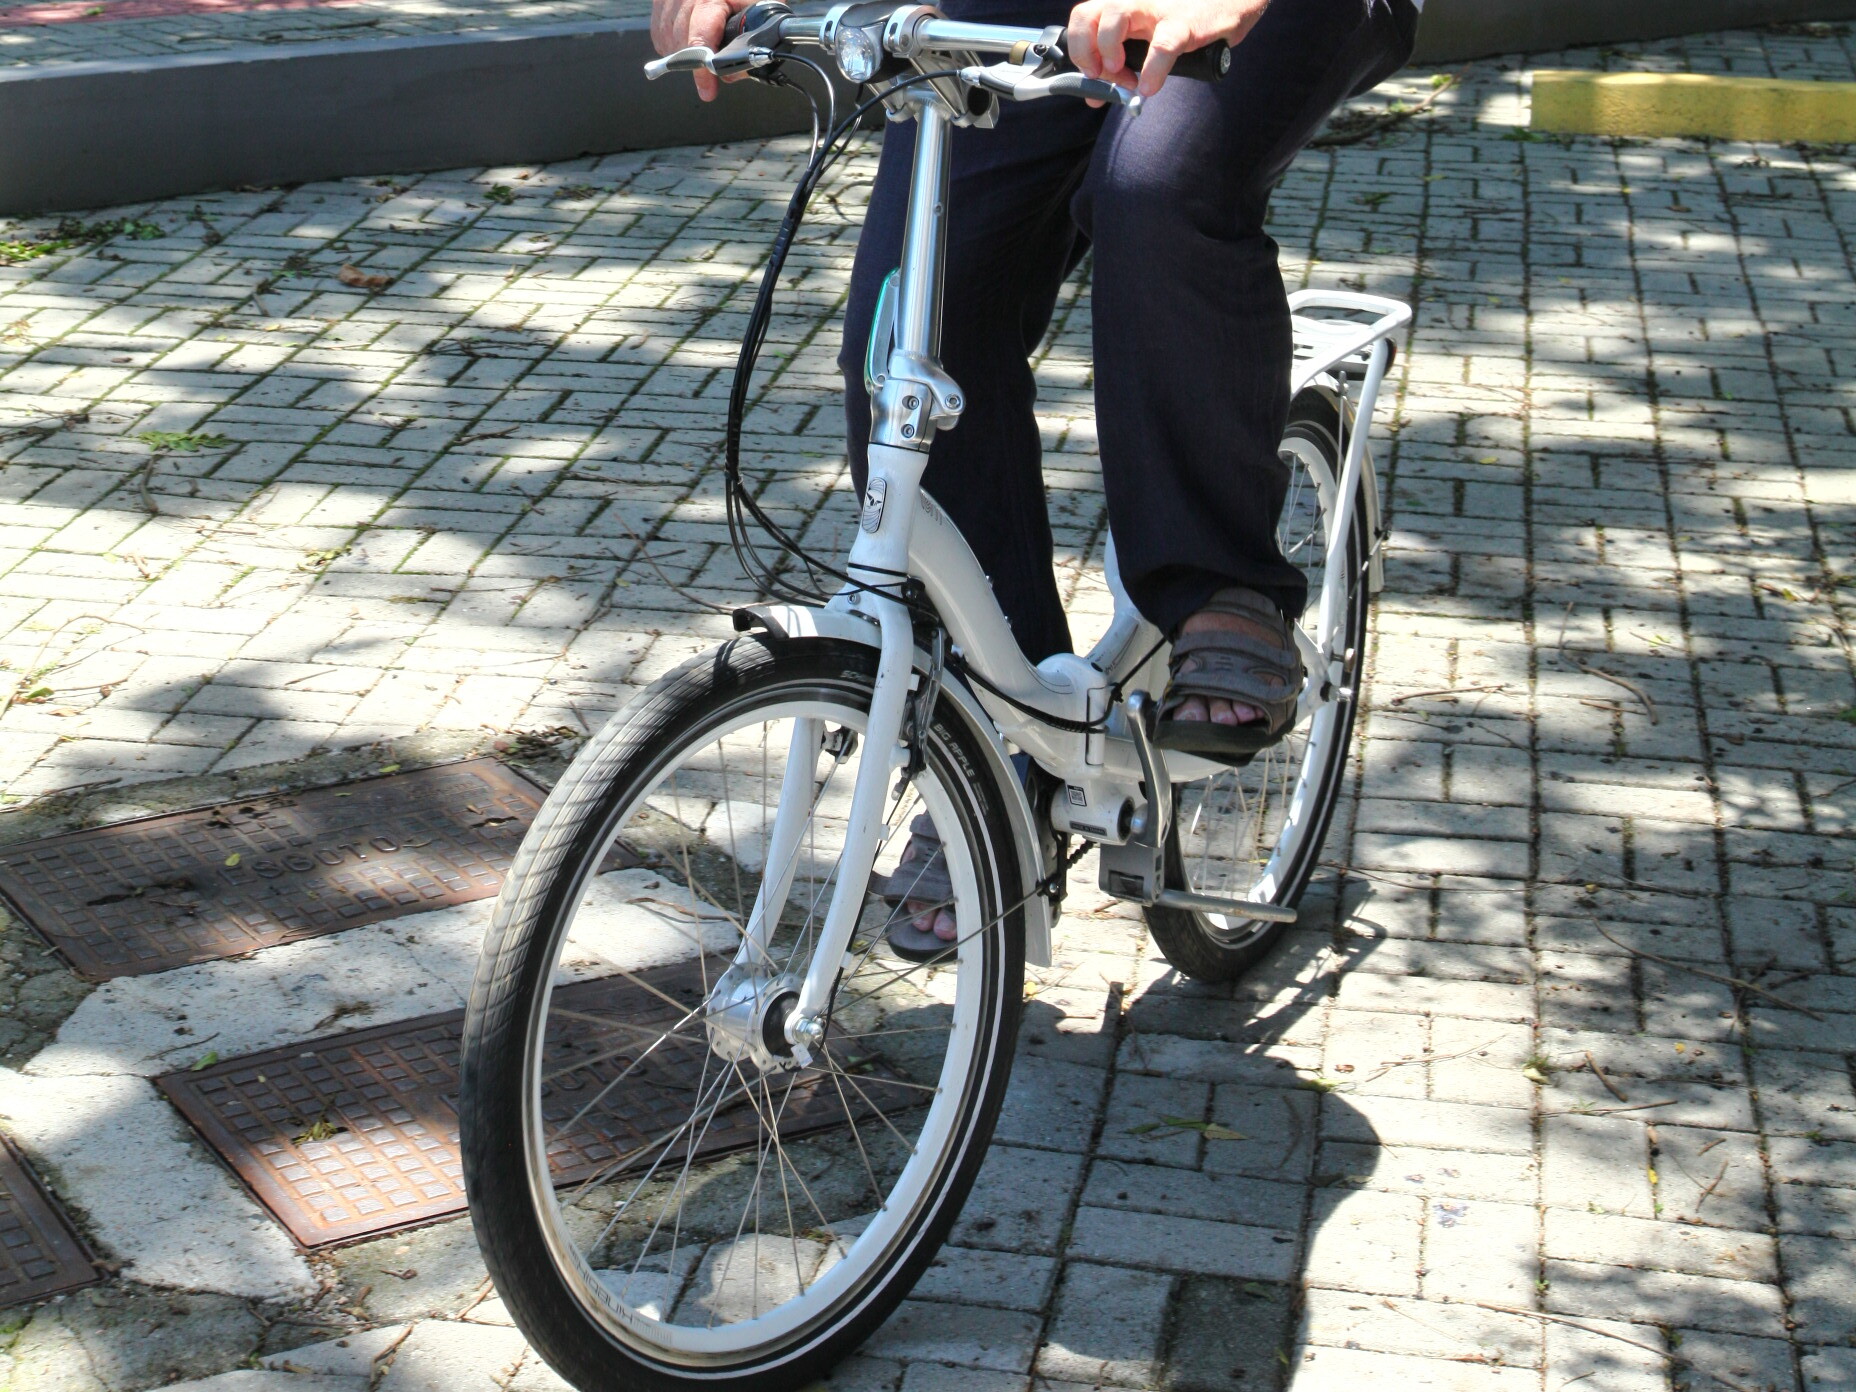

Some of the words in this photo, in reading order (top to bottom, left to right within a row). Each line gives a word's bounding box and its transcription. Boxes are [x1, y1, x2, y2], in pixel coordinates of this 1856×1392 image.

[933, 723, 951, 741] BIG
[949, 742, 975, 777] APPLE
[217, 835, 400, 886] ESGOTO
